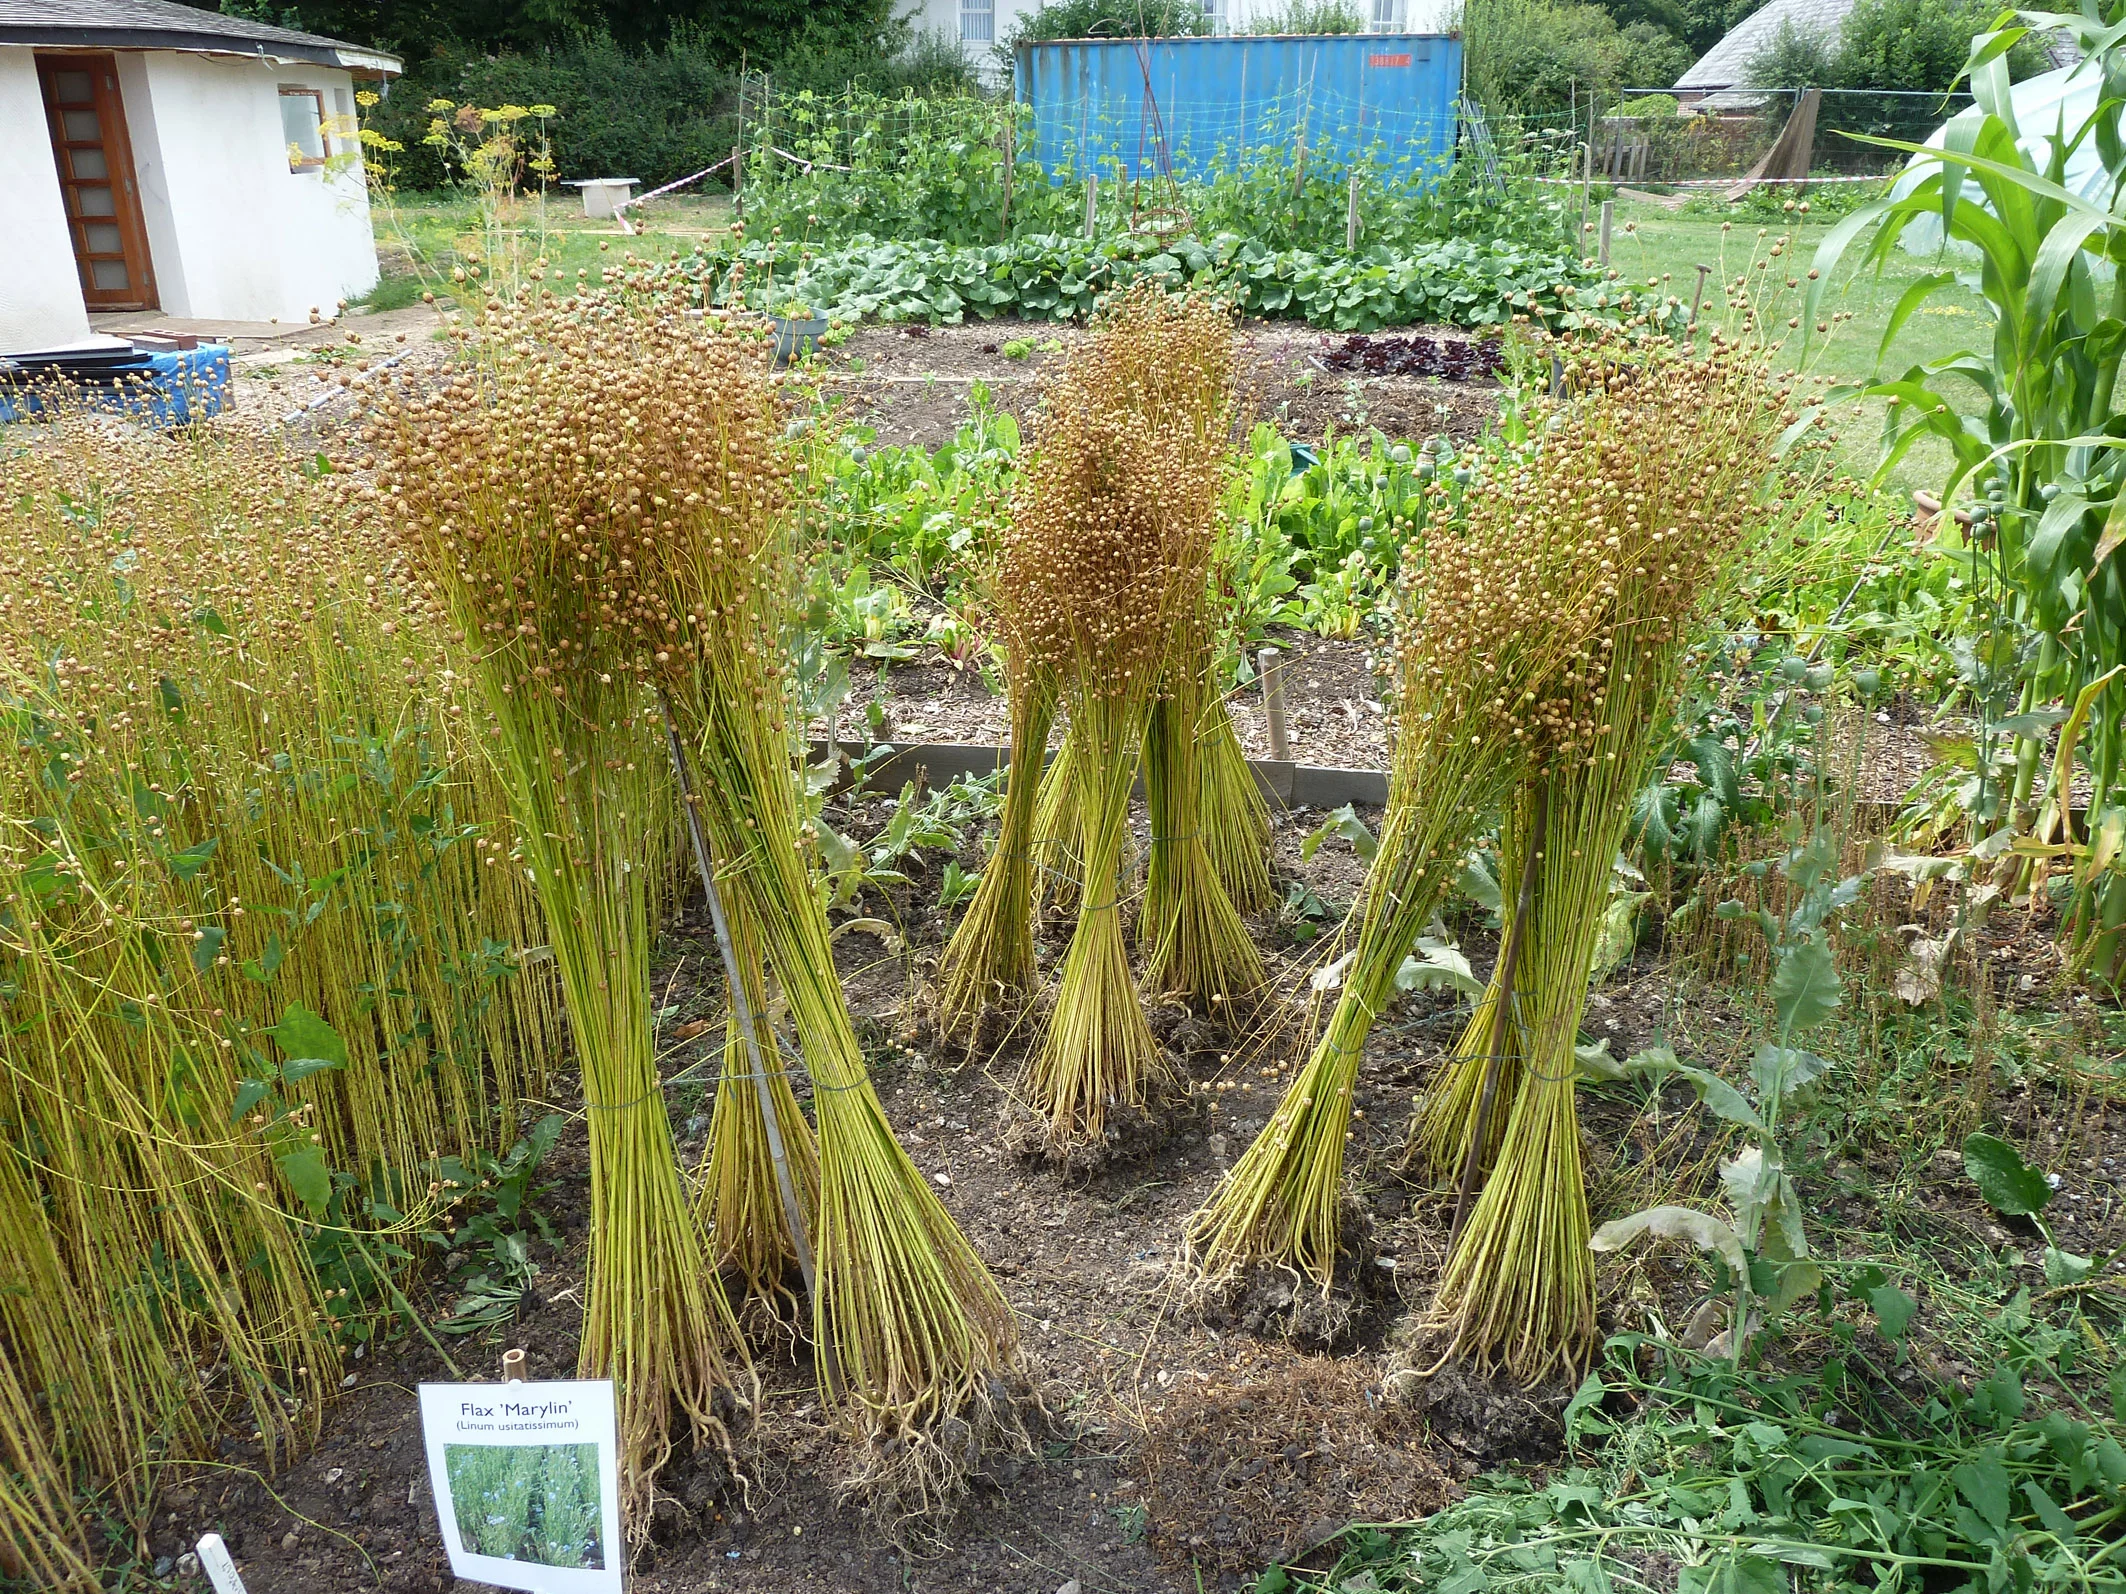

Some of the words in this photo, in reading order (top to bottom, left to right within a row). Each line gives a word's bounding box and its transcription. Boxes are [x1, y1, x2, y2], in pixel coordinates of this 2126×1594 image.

[461, 1402, 495, 1417] Flax
[456, 1420, 495, 1432] (Linum
[498, 1418, 580, 1431] usitatissimum)
